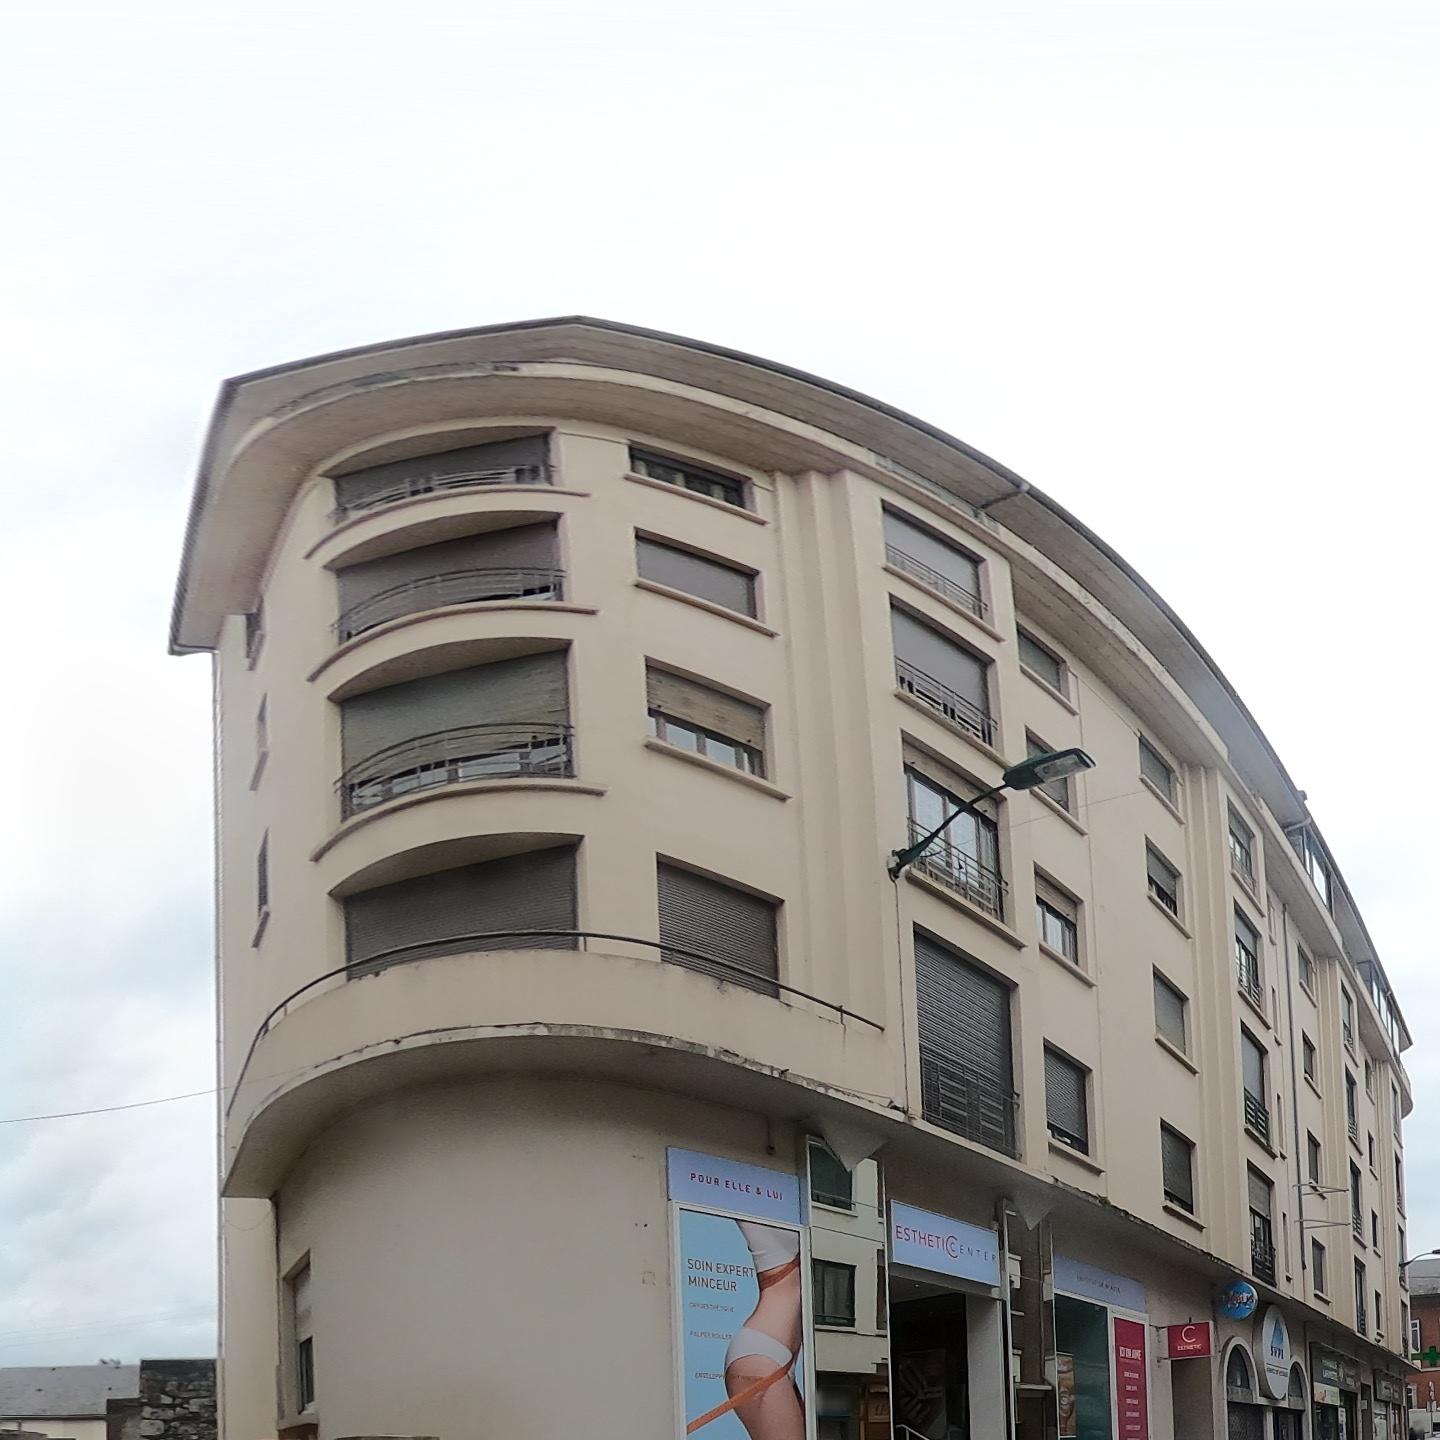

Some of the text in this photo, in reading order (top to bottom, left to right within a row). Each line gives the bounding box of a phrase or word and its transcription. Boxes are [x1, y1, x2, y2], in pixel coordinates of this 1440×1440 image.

[690, 1173, 783, 1201] POUR ELLE & LUI
[687, 1258, 755, 1278] SOIN EXPERT
[688, 1275, 737, 1292] MINCEUR
